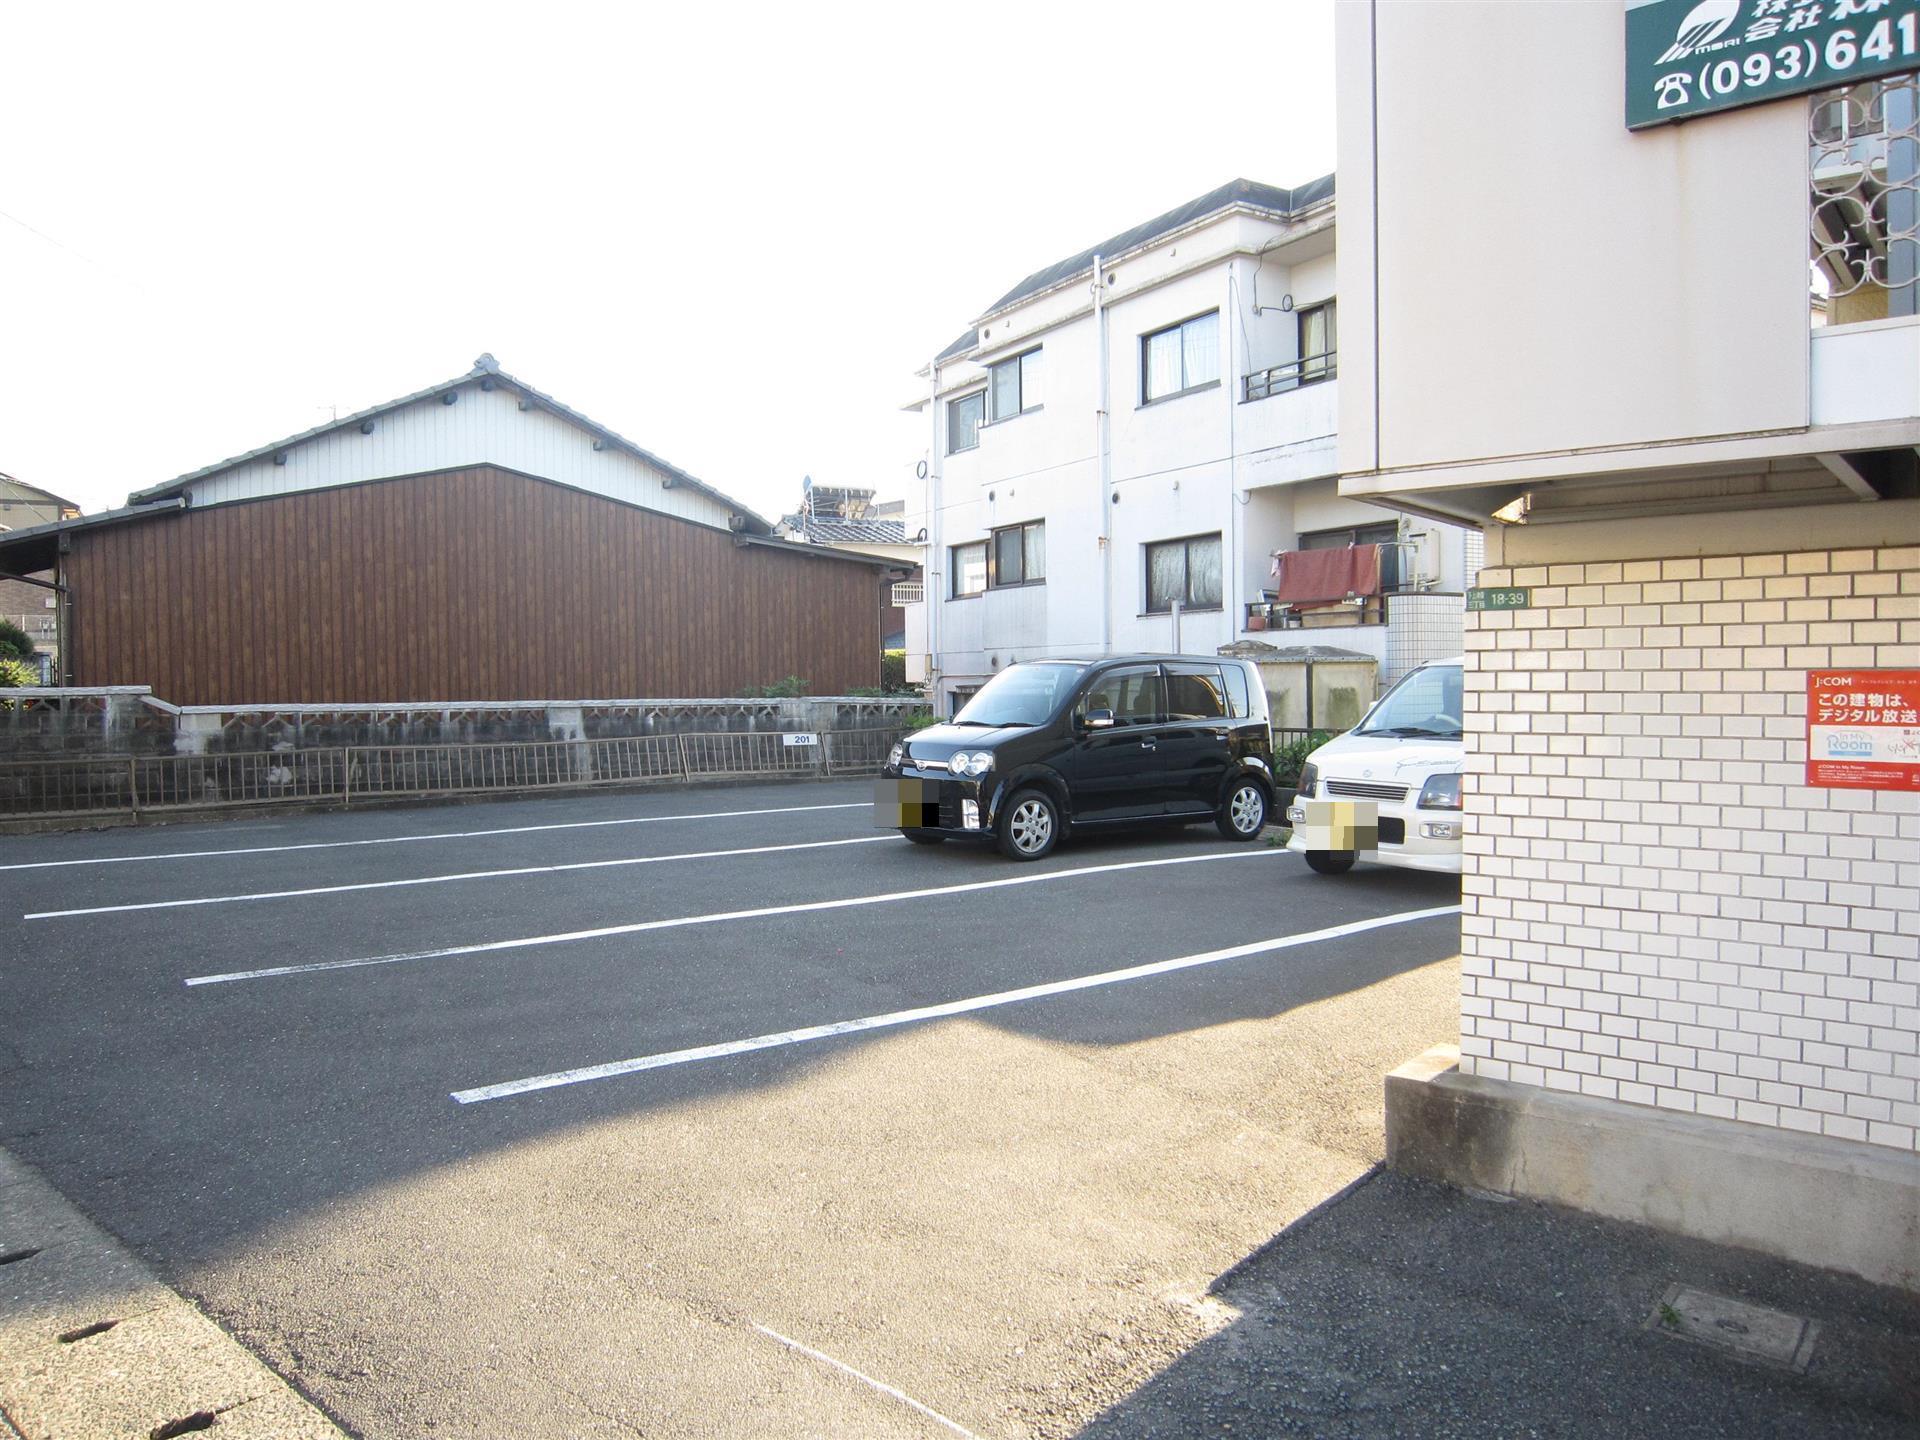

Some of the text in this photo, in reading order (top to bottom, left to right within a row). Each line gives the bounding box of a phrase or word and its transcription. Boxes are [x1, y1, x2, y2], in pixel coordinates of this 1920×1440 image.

[1744, 5, 1823, 43] 会社
[1492, 593, 1524, 605] 18-39
[1815, 677, 1852, 687] J:COM
[1819, 693, 1909, 707] この建物は、
[1819, 709, 1917, 723] デジタル放送
[795, 735, 810, 743] 201
[1827, 735, 1872, 750] Room
